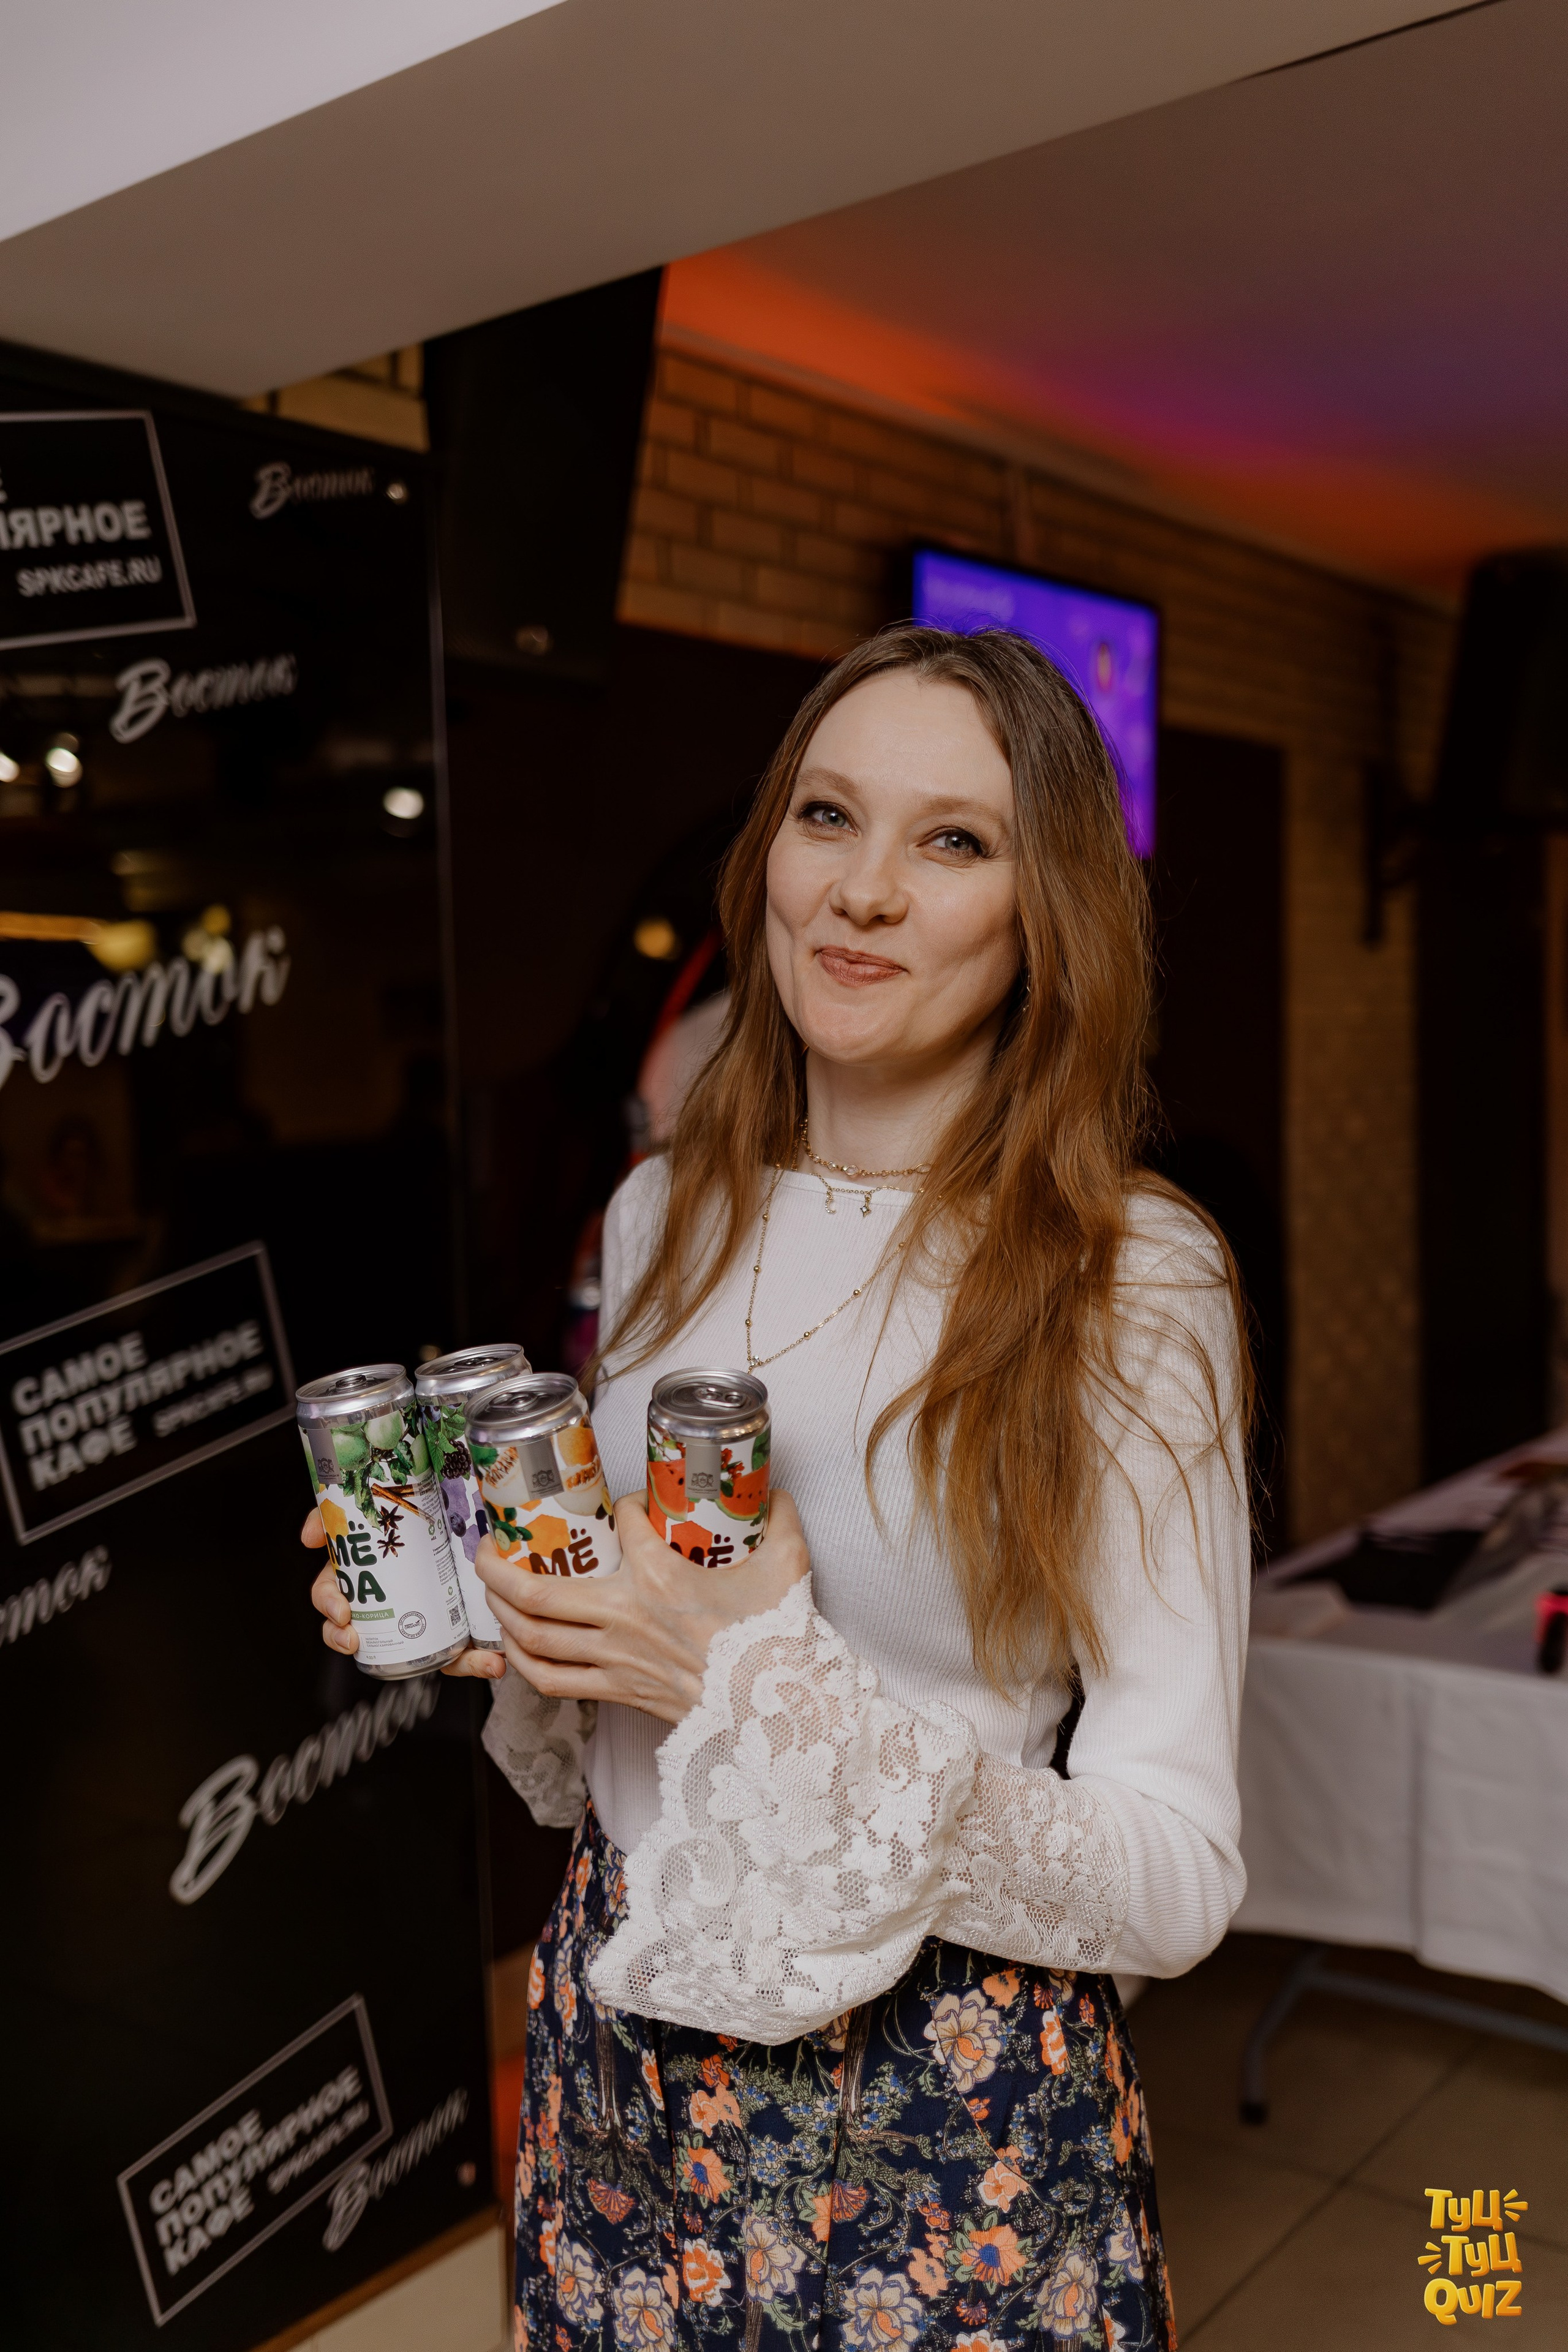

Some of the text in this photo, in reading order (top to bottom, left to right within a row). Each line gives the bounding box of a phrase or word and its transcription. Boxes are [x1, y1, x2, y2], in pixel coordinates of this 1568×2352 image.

[12, 1330, 148, 1416] САМОЕ
[18, 1319, 265, 1457] ПОПУЛЯРНОЕ
[28, 1414, 138, 1493] КАФЕ
[326, 1520, 377, 1567] МЁ
[529, 1528, 599, 1577] МЁ
[148, 2108, 265, 2215] САМОЕ
[154, 2068, 364, 2250] ПОПУЛЯРНОЕ
[163, 2183, 255, 2277] КАФЕ
